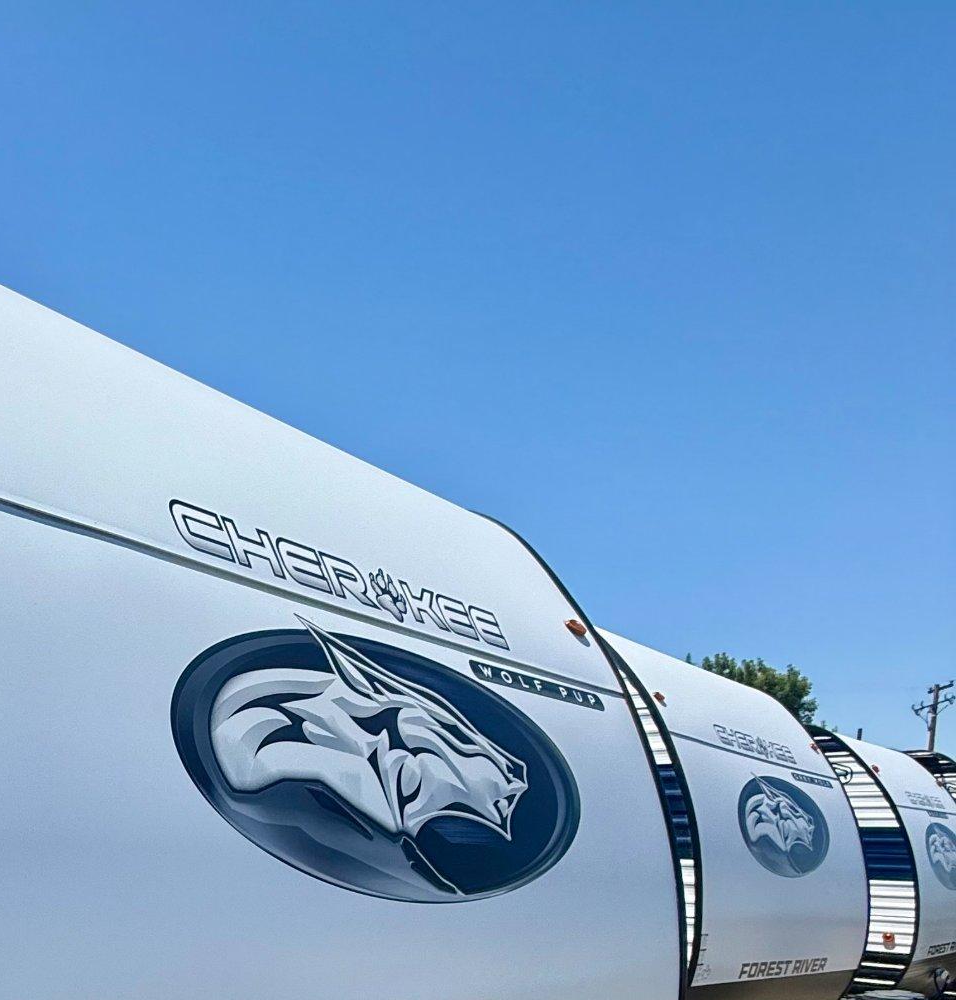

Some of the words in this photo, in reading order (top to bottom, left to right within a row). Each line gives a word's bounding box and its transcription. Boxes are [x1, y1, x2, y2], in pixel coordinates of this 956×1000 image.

[169, 499, 511, 651] CHEROKEE
[477, 664, 544, 692] WOLF
[559, 686, 596, 706] PUP
[738, 960, 792, 979] FOREST
[791, 957, 828, 975] RIVER
